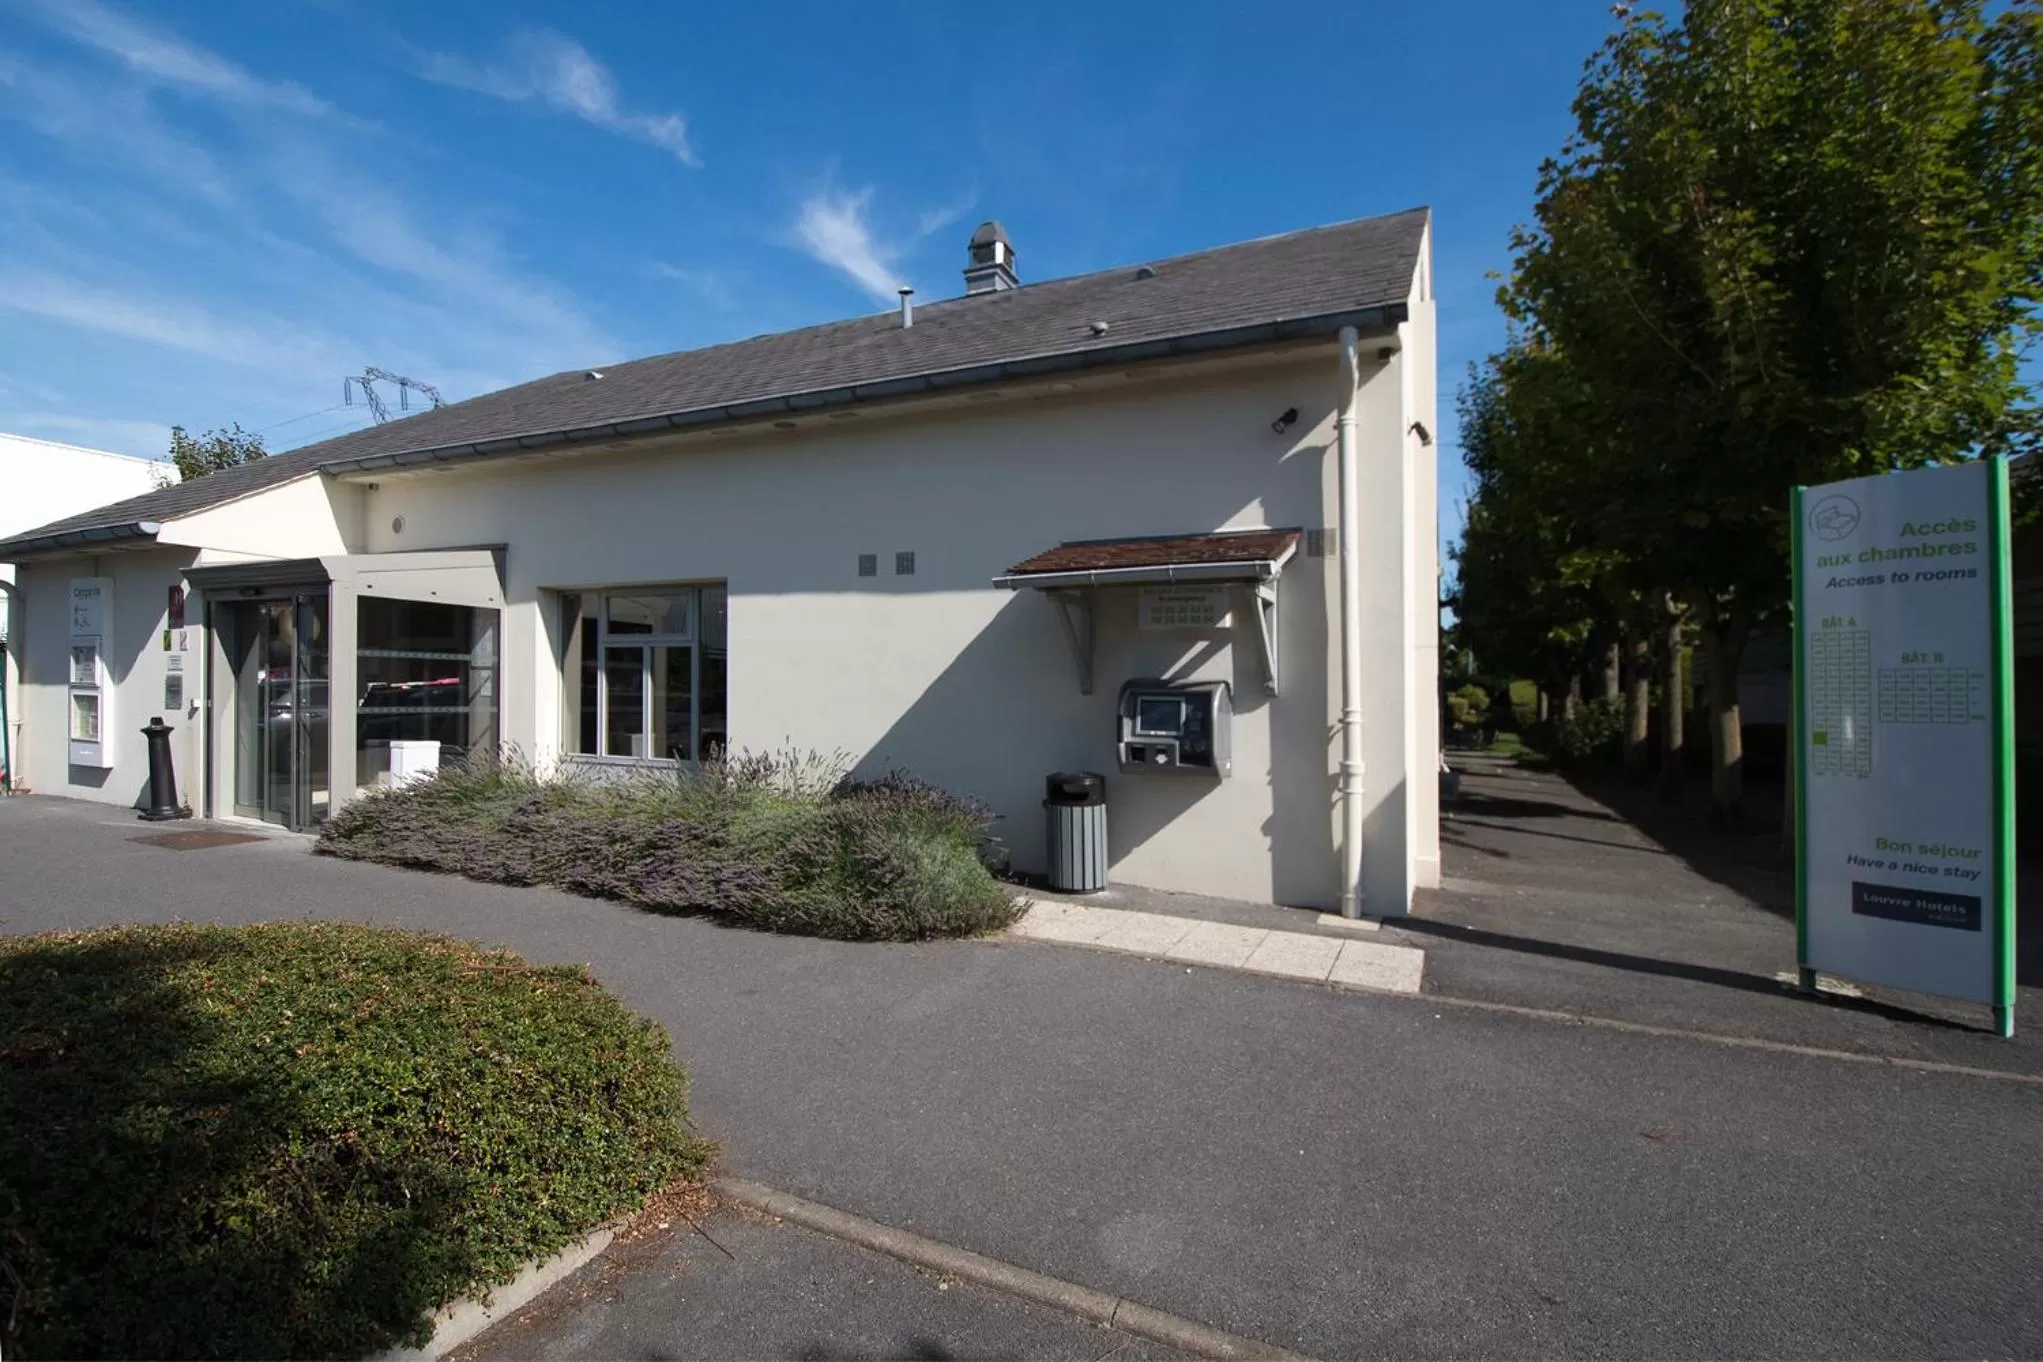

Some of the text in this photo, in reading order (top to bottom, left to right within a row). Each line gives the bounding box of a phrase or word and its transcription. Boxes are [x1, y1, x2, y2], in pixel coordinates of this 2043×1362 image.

[1899, 516, 1977, 537] Accès
[1816, 541, 1978, 569] aux chambres
[1825, 568, 1978, 589] Access to rooms
[1875, 837, 1983, 859] Bon séjour
[1846, 853, 1982, 882] Have a nice stay
[1863, 892, 1968, 914] Louvre Hotels
